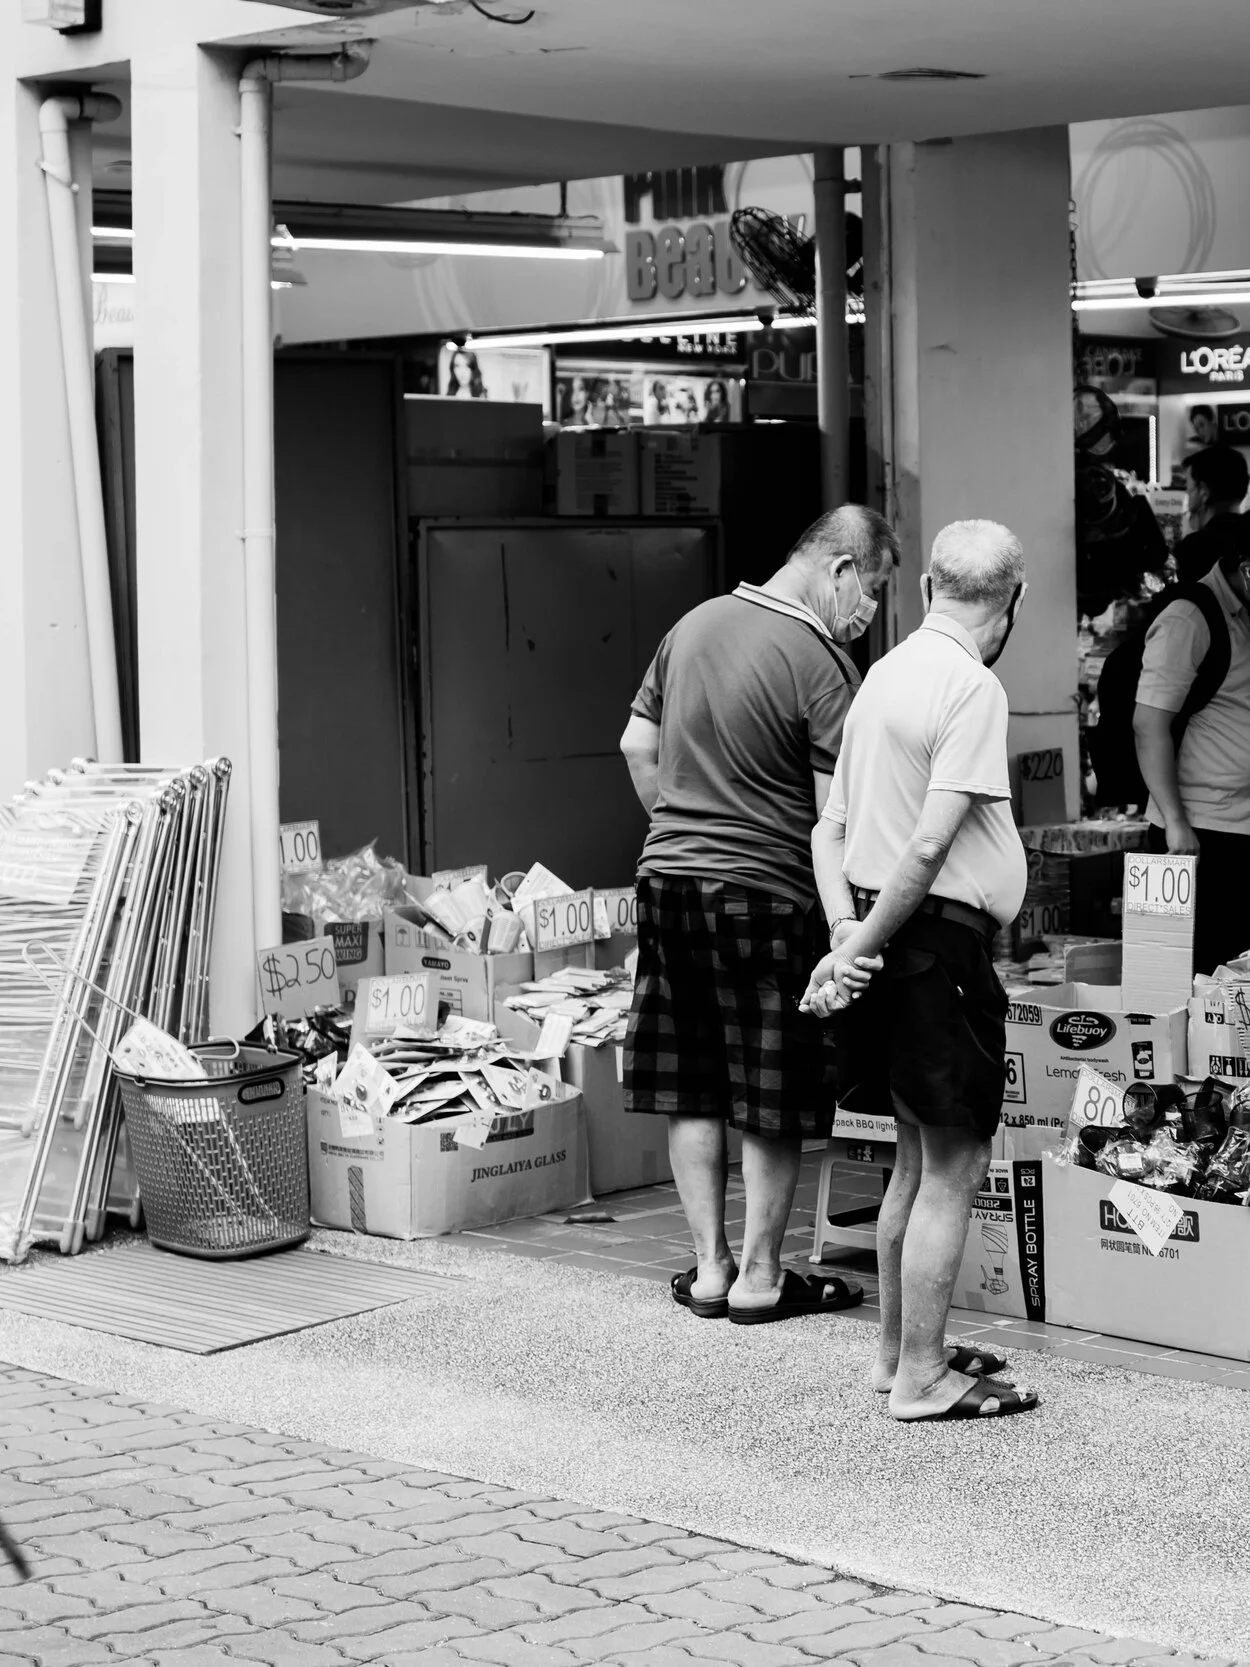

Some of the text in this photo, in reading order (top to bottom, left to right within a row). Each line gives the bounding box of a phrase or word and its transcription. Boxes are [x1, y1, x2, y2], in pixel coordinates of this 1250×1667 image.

[1209, 370, 1245, 382] PARIS
[1128, 865, 1191, 905] $1.00
[539, 900, 590, 937] $1.00
[335, 923, 362, 933] SUPER
[335, 935, 362, 947] MAXI
[372, 983, 425, 1019] $1.00
[1056, 1023, 1108, 1038] Lifebuoy
[856, 1119, 875, 1130] BBQ
[1019, 1114, 1035, 1126] 850
[471, 1150, 567, 1183] JINGLAIYA GLASS
[1023, 1199, 1041, 1307] SPRAY BOTTLE
